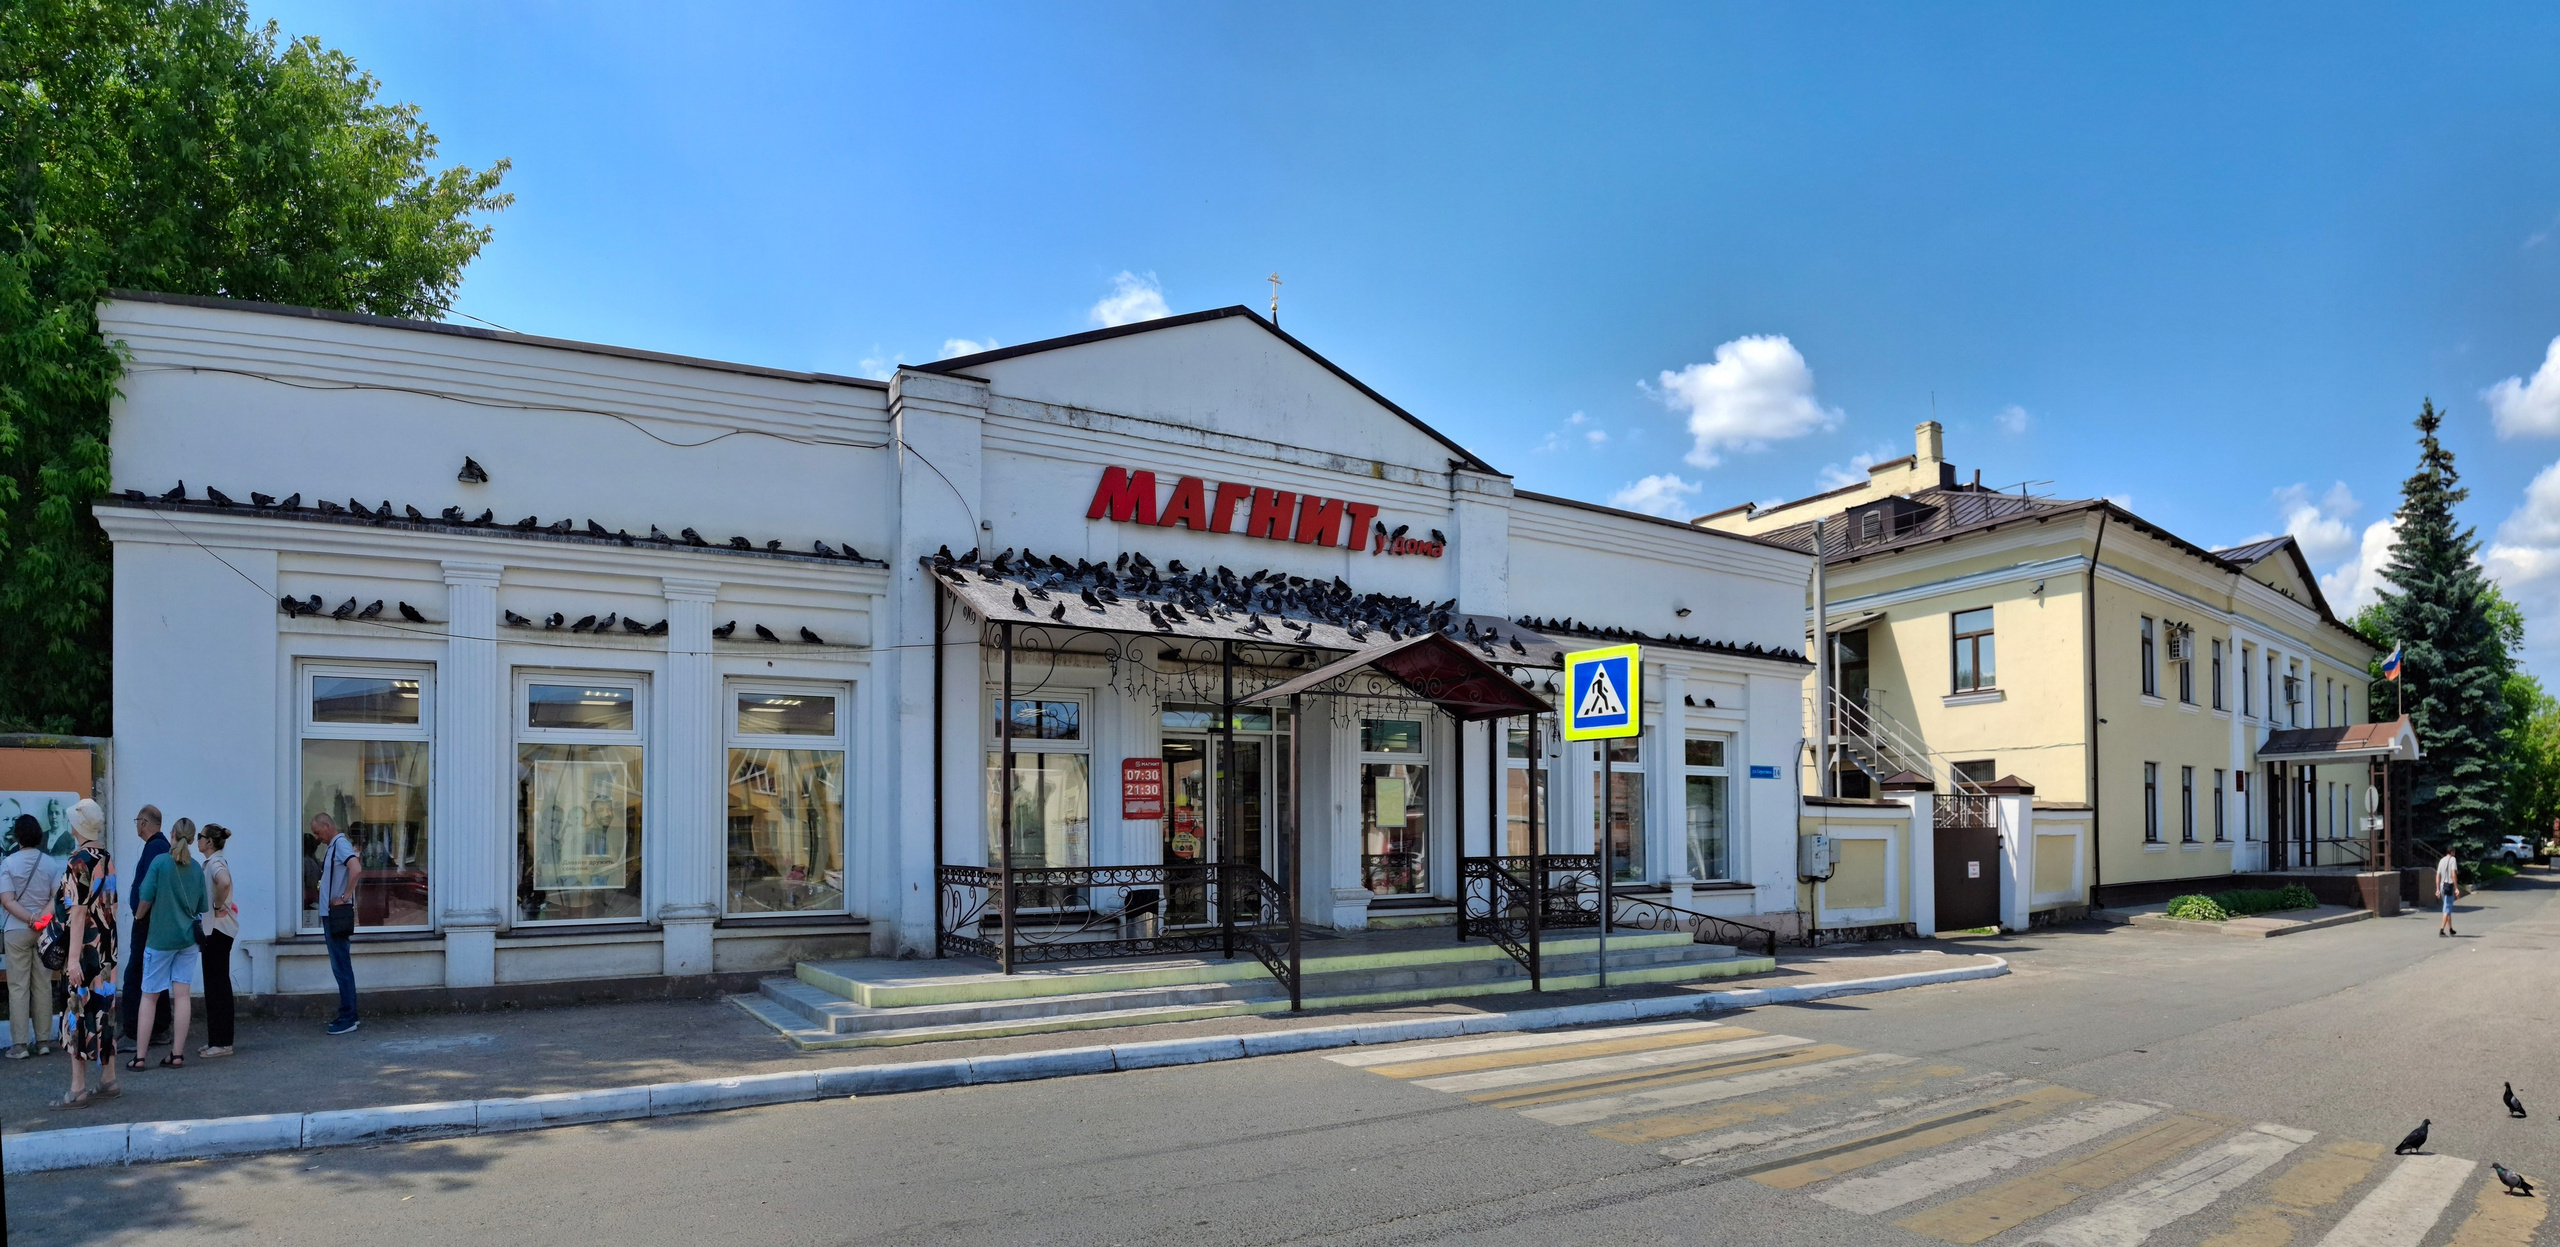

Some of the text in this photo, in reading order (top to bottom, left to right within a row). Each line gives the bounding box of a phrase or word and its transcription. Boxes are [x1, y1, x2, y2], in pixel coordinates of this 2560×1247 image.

[1086, 466, 1379, 551] МАГНИТ
[1389, 536, 1443, 558] дома
[1127, 770, 1159, 780] 07:30
[1127, 784, 1159, 795] 21:30
